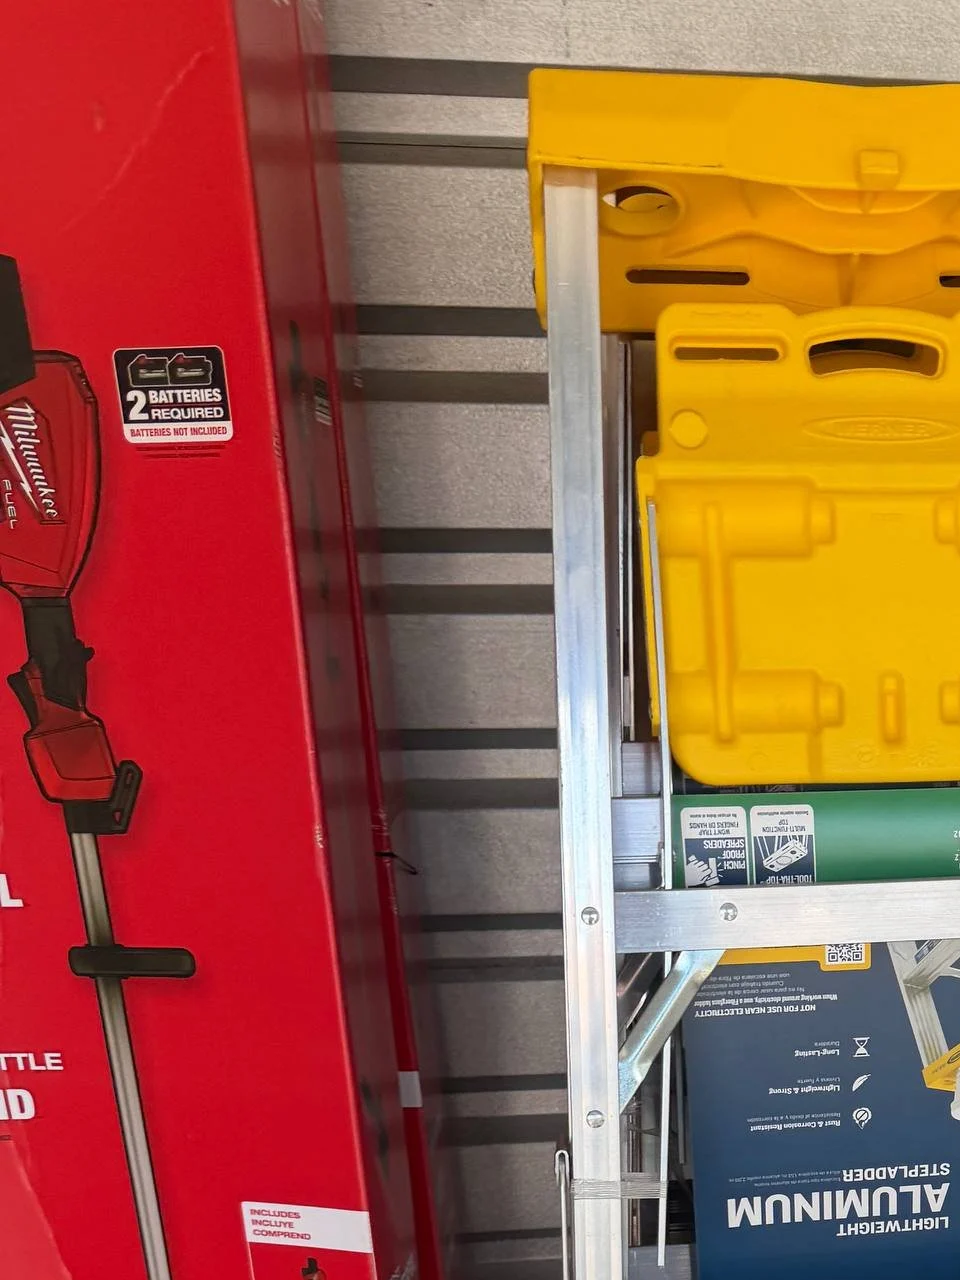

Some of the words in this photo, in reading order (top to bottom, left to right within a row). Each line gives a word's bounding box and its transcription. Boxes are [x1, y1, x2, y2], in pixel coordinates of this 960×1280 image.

[126, 390, 149, 421] 2
[150, 388, 222, 404] BATTERIES
[151, 406, 224, 420] REQUIRED
[130, 428, 172, 438] BATTERIES
[172, 427, 189, 436] NOT
[190, 426, 228, 436] INCLUDED
[2, 400, 60, 520] Milwaukee
[2, 478, 19, 530] FUEL
[703, 838, 745, 849] SPREADERS
[722, 850, 745, 859] PROOF
[723, 860, 746, 870] PINCH
[744, 1006, 766, 1016] NEAR
[766, 1006, 782, 1014] USE
[783, 1005, 799, 1013] FOR
[800, 1003, 816, 1012] NOT
[694, 1008, 744, 1018] ELECTRICITY
[794, 1048, 840, 1058] Long-Lasting
[768, 1087, 792, 1095] Strong
[793, 1087, 800, 1095] &
[800, 1084, 840, 1093] Lightweight
[750, 1123, 783, 1132] Resistant
[783, 1121, 816, 1129] Corrosion
[842, 1162, 951, 1182] STEPLADDER
[727, 1182, 950, 1228] ALUMINUM
[250, 1208, 301, 1219] INCLUDES
[251, 1218, 294, 1229] INCLUYE
[836, 1216, 949, 1237] LIGHTWEIGHT
[252, 1228, 311, 1240] COMPREND
